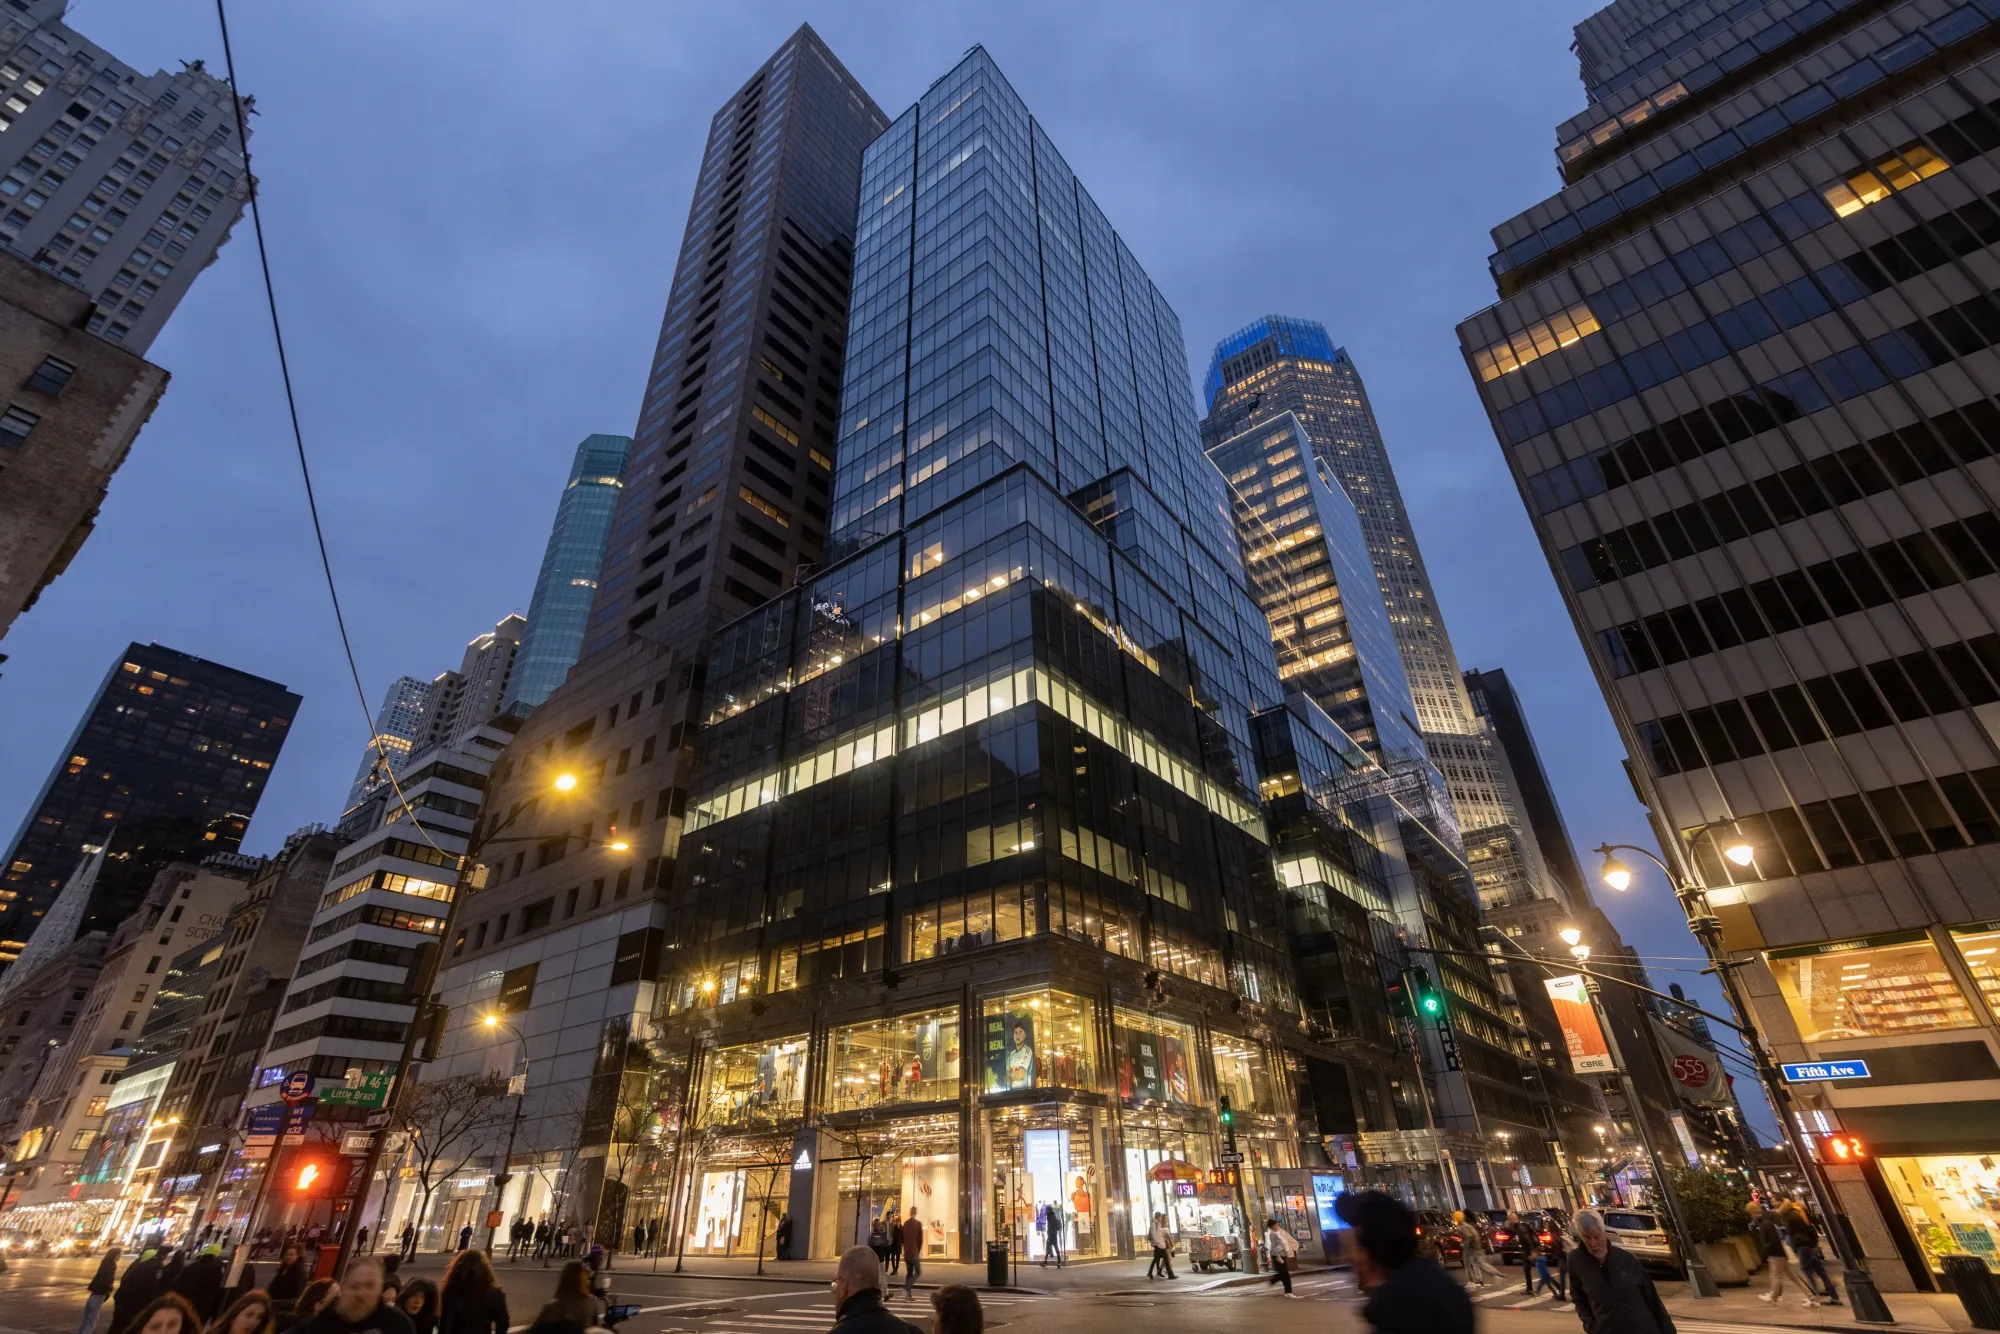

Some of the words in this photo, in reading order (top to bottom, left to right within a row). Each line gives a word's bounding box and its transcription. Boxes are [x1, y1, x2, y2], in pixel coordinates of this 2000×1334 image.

[506, 985, 527, 996] ALLSAINTS
[989, 1021, 1004, 1033] REAL
[989, 1039, 1004, 1051] REAL
[1580, 1060, 1604, 1068] CBRE
[1674, 1058, 1704, 1081] 555
[1796, 1066, 1829, 1078] Fifth
[1830, 1065, 1855, 1076] Ave
[360, 1075, 368, 1087] W
[370, 1076, 382, 1089] 46
[331, 1088, 352, 1099] Little
[354, 1090, 377, 1101] Brazil
[352, 1137, 372, 1147] ONE
[1850, 1138, 1866, 1157] 2
[1957, 1232, 1988, 1242] STARTS
[1961, 1242, 1983, 1252] WITH
